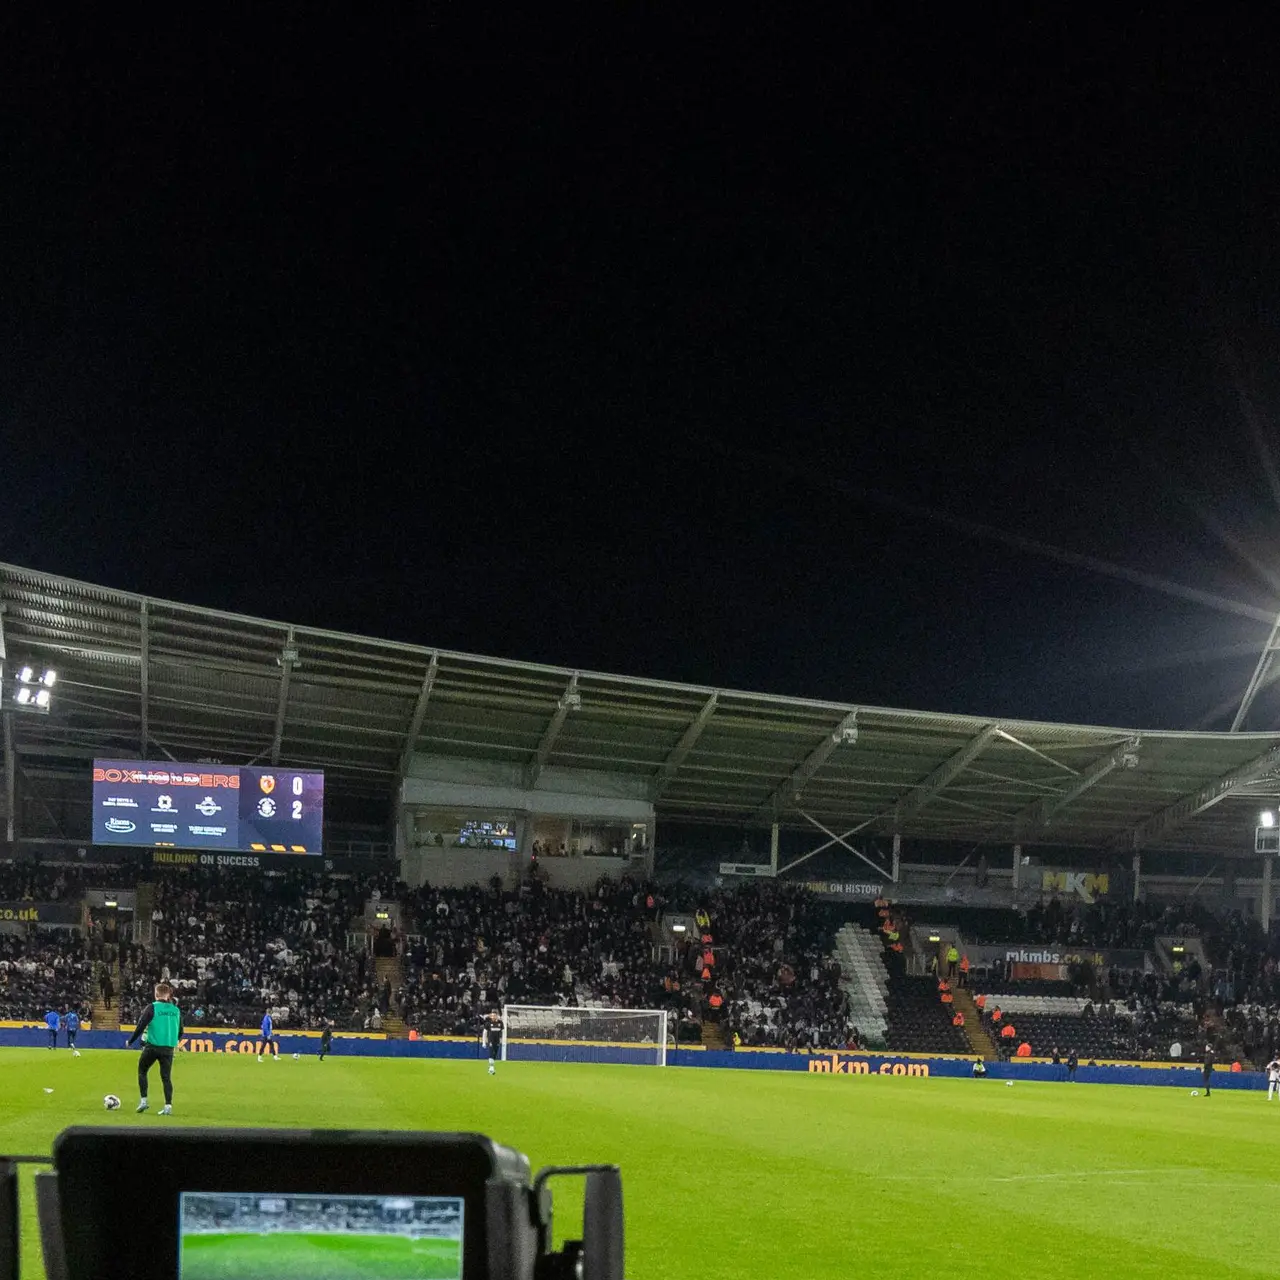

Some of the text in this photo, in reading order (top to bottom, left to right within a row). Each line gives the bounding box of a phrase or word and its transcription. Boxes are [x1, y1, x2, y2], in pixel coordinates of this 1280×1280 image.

[293, 777, 303, 795] 0
[292, 800, 302, 819] 2
[200, 854, 214, 864] ON
[216, 855, 260, 867] SUCCESS
[829, 883, 843, 893] ON
[845, 884, 884, 895] HISTORY
[1042, 871, 1109, 904] MKM
[809, 1055, 930, 1077] mkm.com
